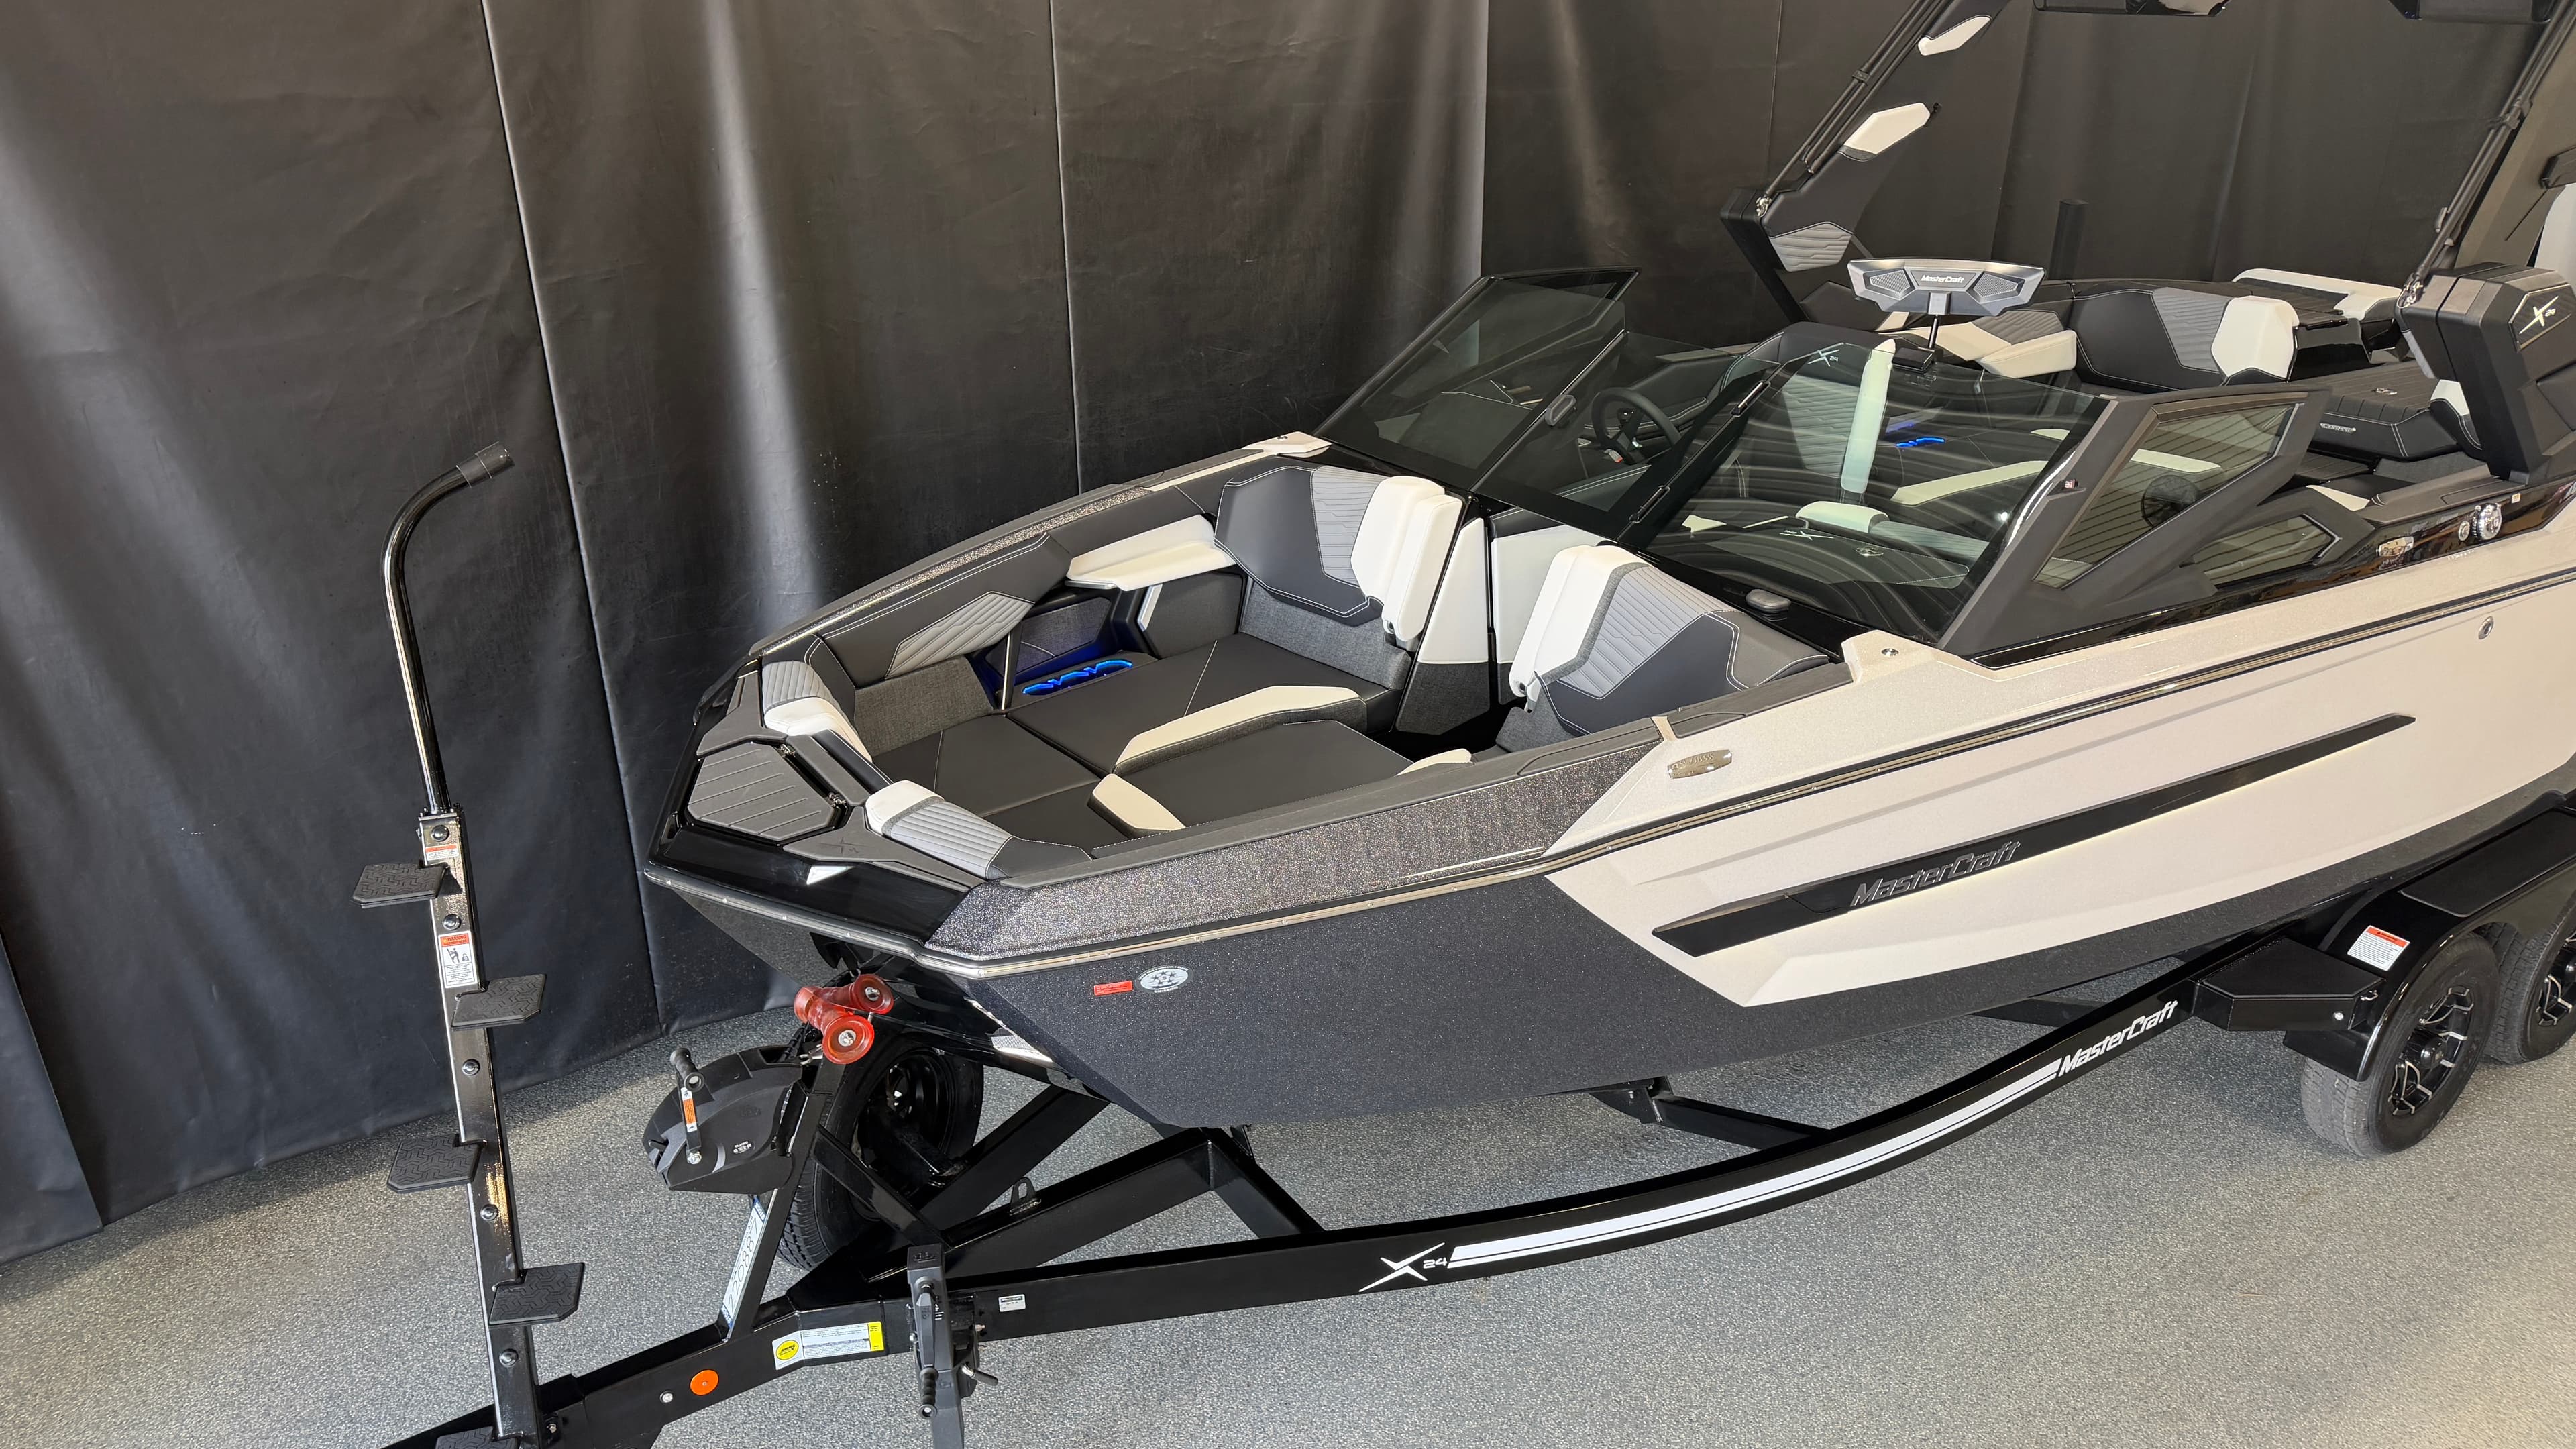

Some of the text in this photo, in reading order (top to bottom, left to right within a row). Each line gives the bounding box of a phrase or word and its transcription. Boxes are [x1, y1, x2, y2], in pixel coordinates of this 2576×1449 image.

[1921, 274, 1965, 284] MasterCraft
[1850, 841, 2021, 907] MasterCraft
[2058, 1000, 2179, 1077] MasterCraft
[728, 1217, 758, 1311] 220887
